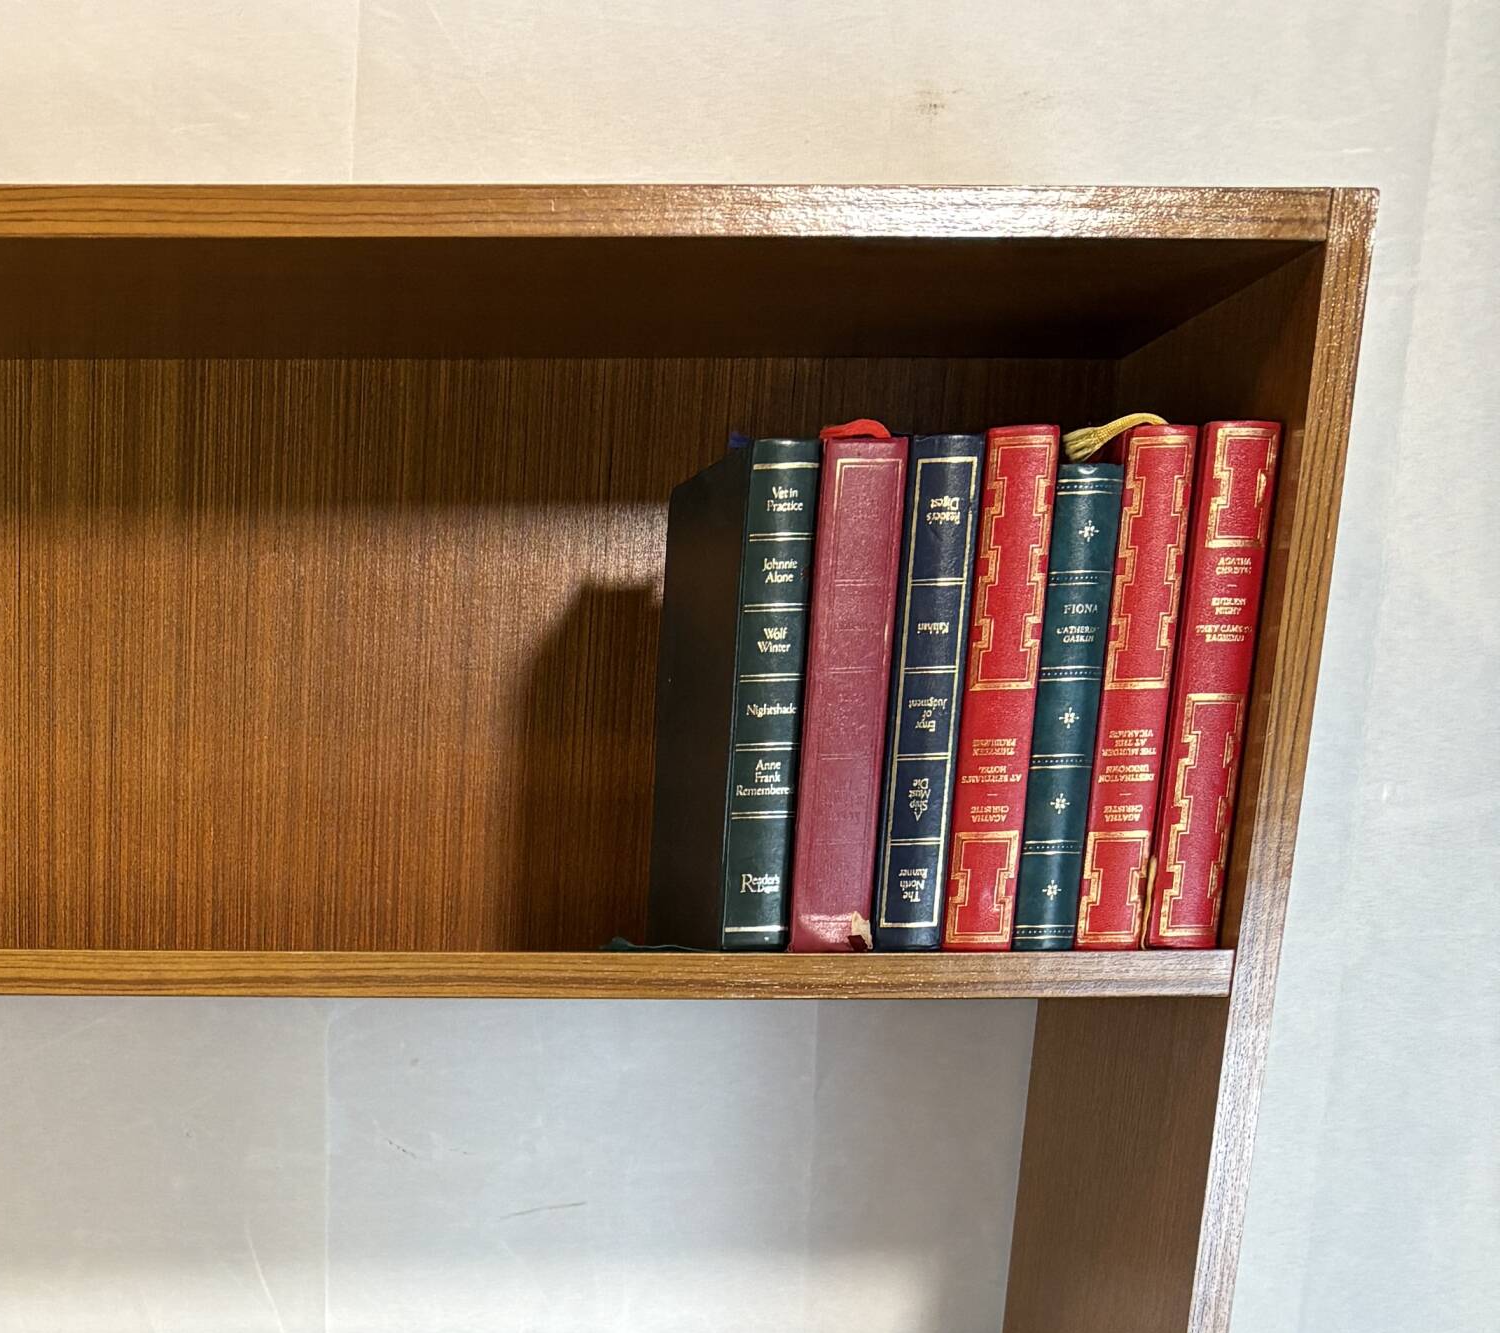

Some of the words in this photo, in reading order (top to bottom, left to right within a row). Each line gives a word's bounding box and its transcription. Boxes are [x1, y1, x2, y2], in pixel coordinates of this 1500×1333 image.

[772, 486, 789, 499] Vet
[789, 487, 798, 498] in
[767, 500, 803, 512] Practice
[930, 496, 960, 510] Digest
[926, 511, 961, 525] Reader's
[762, 558, 798, 571] Johnnie
[765, 572, 794, 584] Alone
[1063, 603, 1098, 615] FIONA
[763, 627, 788, 640] Wolf
[917, 621, 949, 635] Kalahari
[1062, 634, 1095, 644] GASKIN
[757, 641, 791, 653] Winter
[746, 703, 797, 718] Nightshade
[908, 698, 948, 711] Judgment
[922, 709, 933, 719] of
[915, 720, 936, 732] Error
[1134, 738, 1148, 747] AT
[1139, 747, 1156, 756] THE
[755, 759, 781, 771] Anne
[978, 765, 1007, 774] HOTEL
[1106, 764, 1149, 774] UNKNOWN
[755, 771, 781, 783] Frank
[912, 777, 929, 789] Die
[1009, 774, 1022, 783] AT
[1098, 773, 1155, 783] DESTINATION
[736, 784, 794, 797] Remembere
[908, 789, 931, 800] Must
[909, 800, 928, 813] Ship
[970, 805, 1010, 814] CHRISTIE
[1103, 804, 1144, 814] CHRISTIE
[914, 810, 923, 822] A
[971, 814, 1007, 823] AGATHA
[1104, 813, 1141, 822] AGATHA
[898, 868, 928, 880] Runner
[740, 873, 780, 893] Reader's
[757, 884, 780, 894] Digest
[900, 879, 925, 891] North
[902, 890, 921, 903] The
